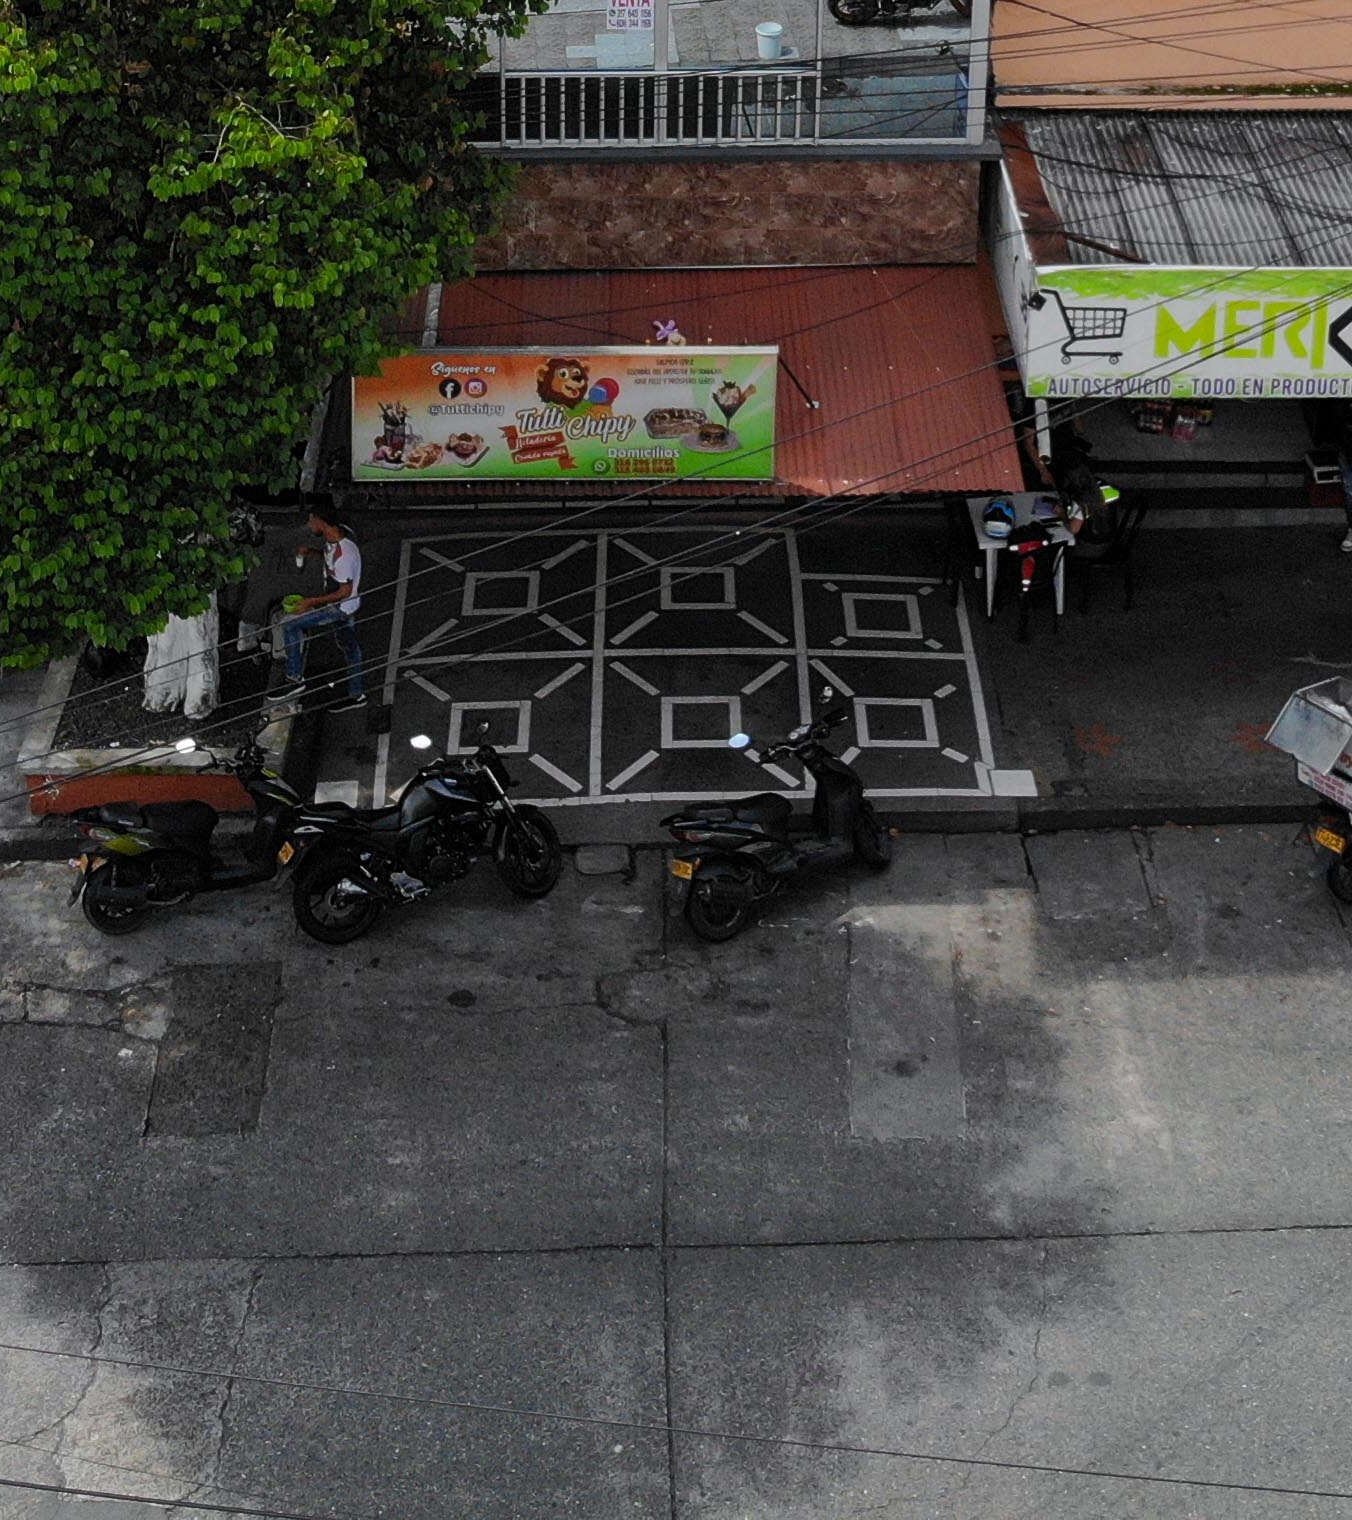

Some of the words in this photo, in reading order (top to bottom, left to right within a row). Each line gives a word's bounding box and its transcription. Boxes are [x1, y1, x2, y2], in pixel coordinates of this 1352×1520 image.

[1048, 378, 1172, 395] AUTOSERVICIO
[1191, 378, 1236, 395] TODO
[1242, 378, 1264, 394] EN
[516, 406, 567, 435] Tutti
[565, 414, 637, 444] Chipy
[607, 447, 681, 459] Domicilios
